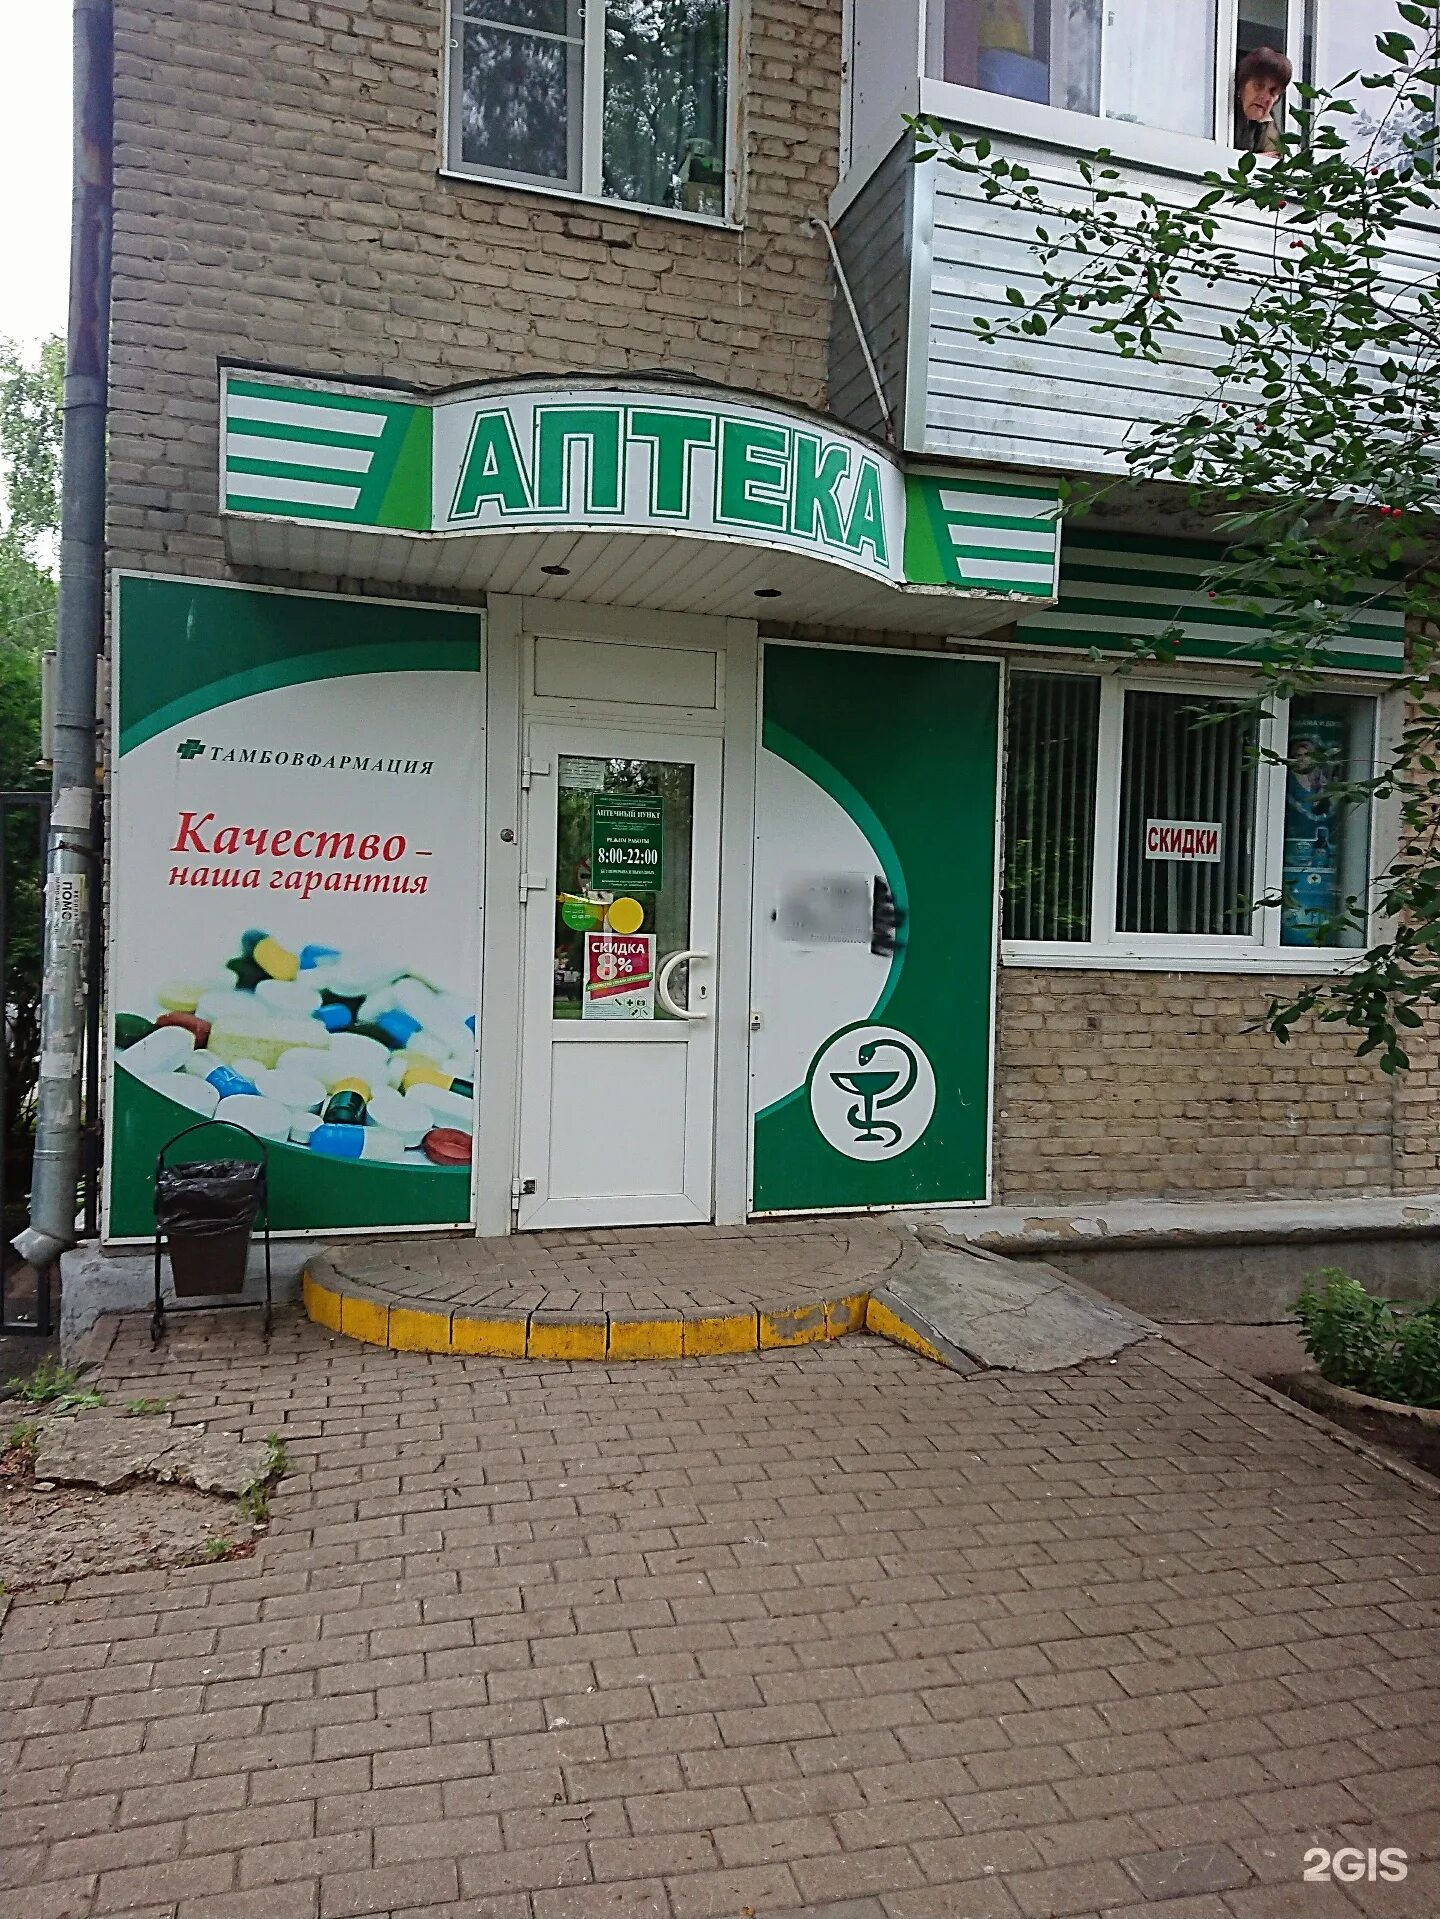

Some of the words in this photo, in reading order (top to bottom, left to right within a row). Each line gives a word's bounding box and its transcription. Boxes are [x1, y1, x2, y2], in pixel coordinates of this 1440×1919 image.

[448, 403, 890, 569] АПТЕКА
[210, 745, 434, 776] ТАМБОВФАРМАЦИЯ
[596, 809, 636, 818] АПТЕЧНЫЙ
[637, 811, 661, 819] ПУНКТ
[169, 811, 407, 862] Качество
[1148, 826, 1218, 858] СКИДКИ
[598, 847, 658, 865] 8:00-22:00
[168, 865, 261, 889] наша
[269, 869, 428, 901] гарантия
[591, 942, 645, 956] СКИДКА
[596, 952, 633, 981] 8%
